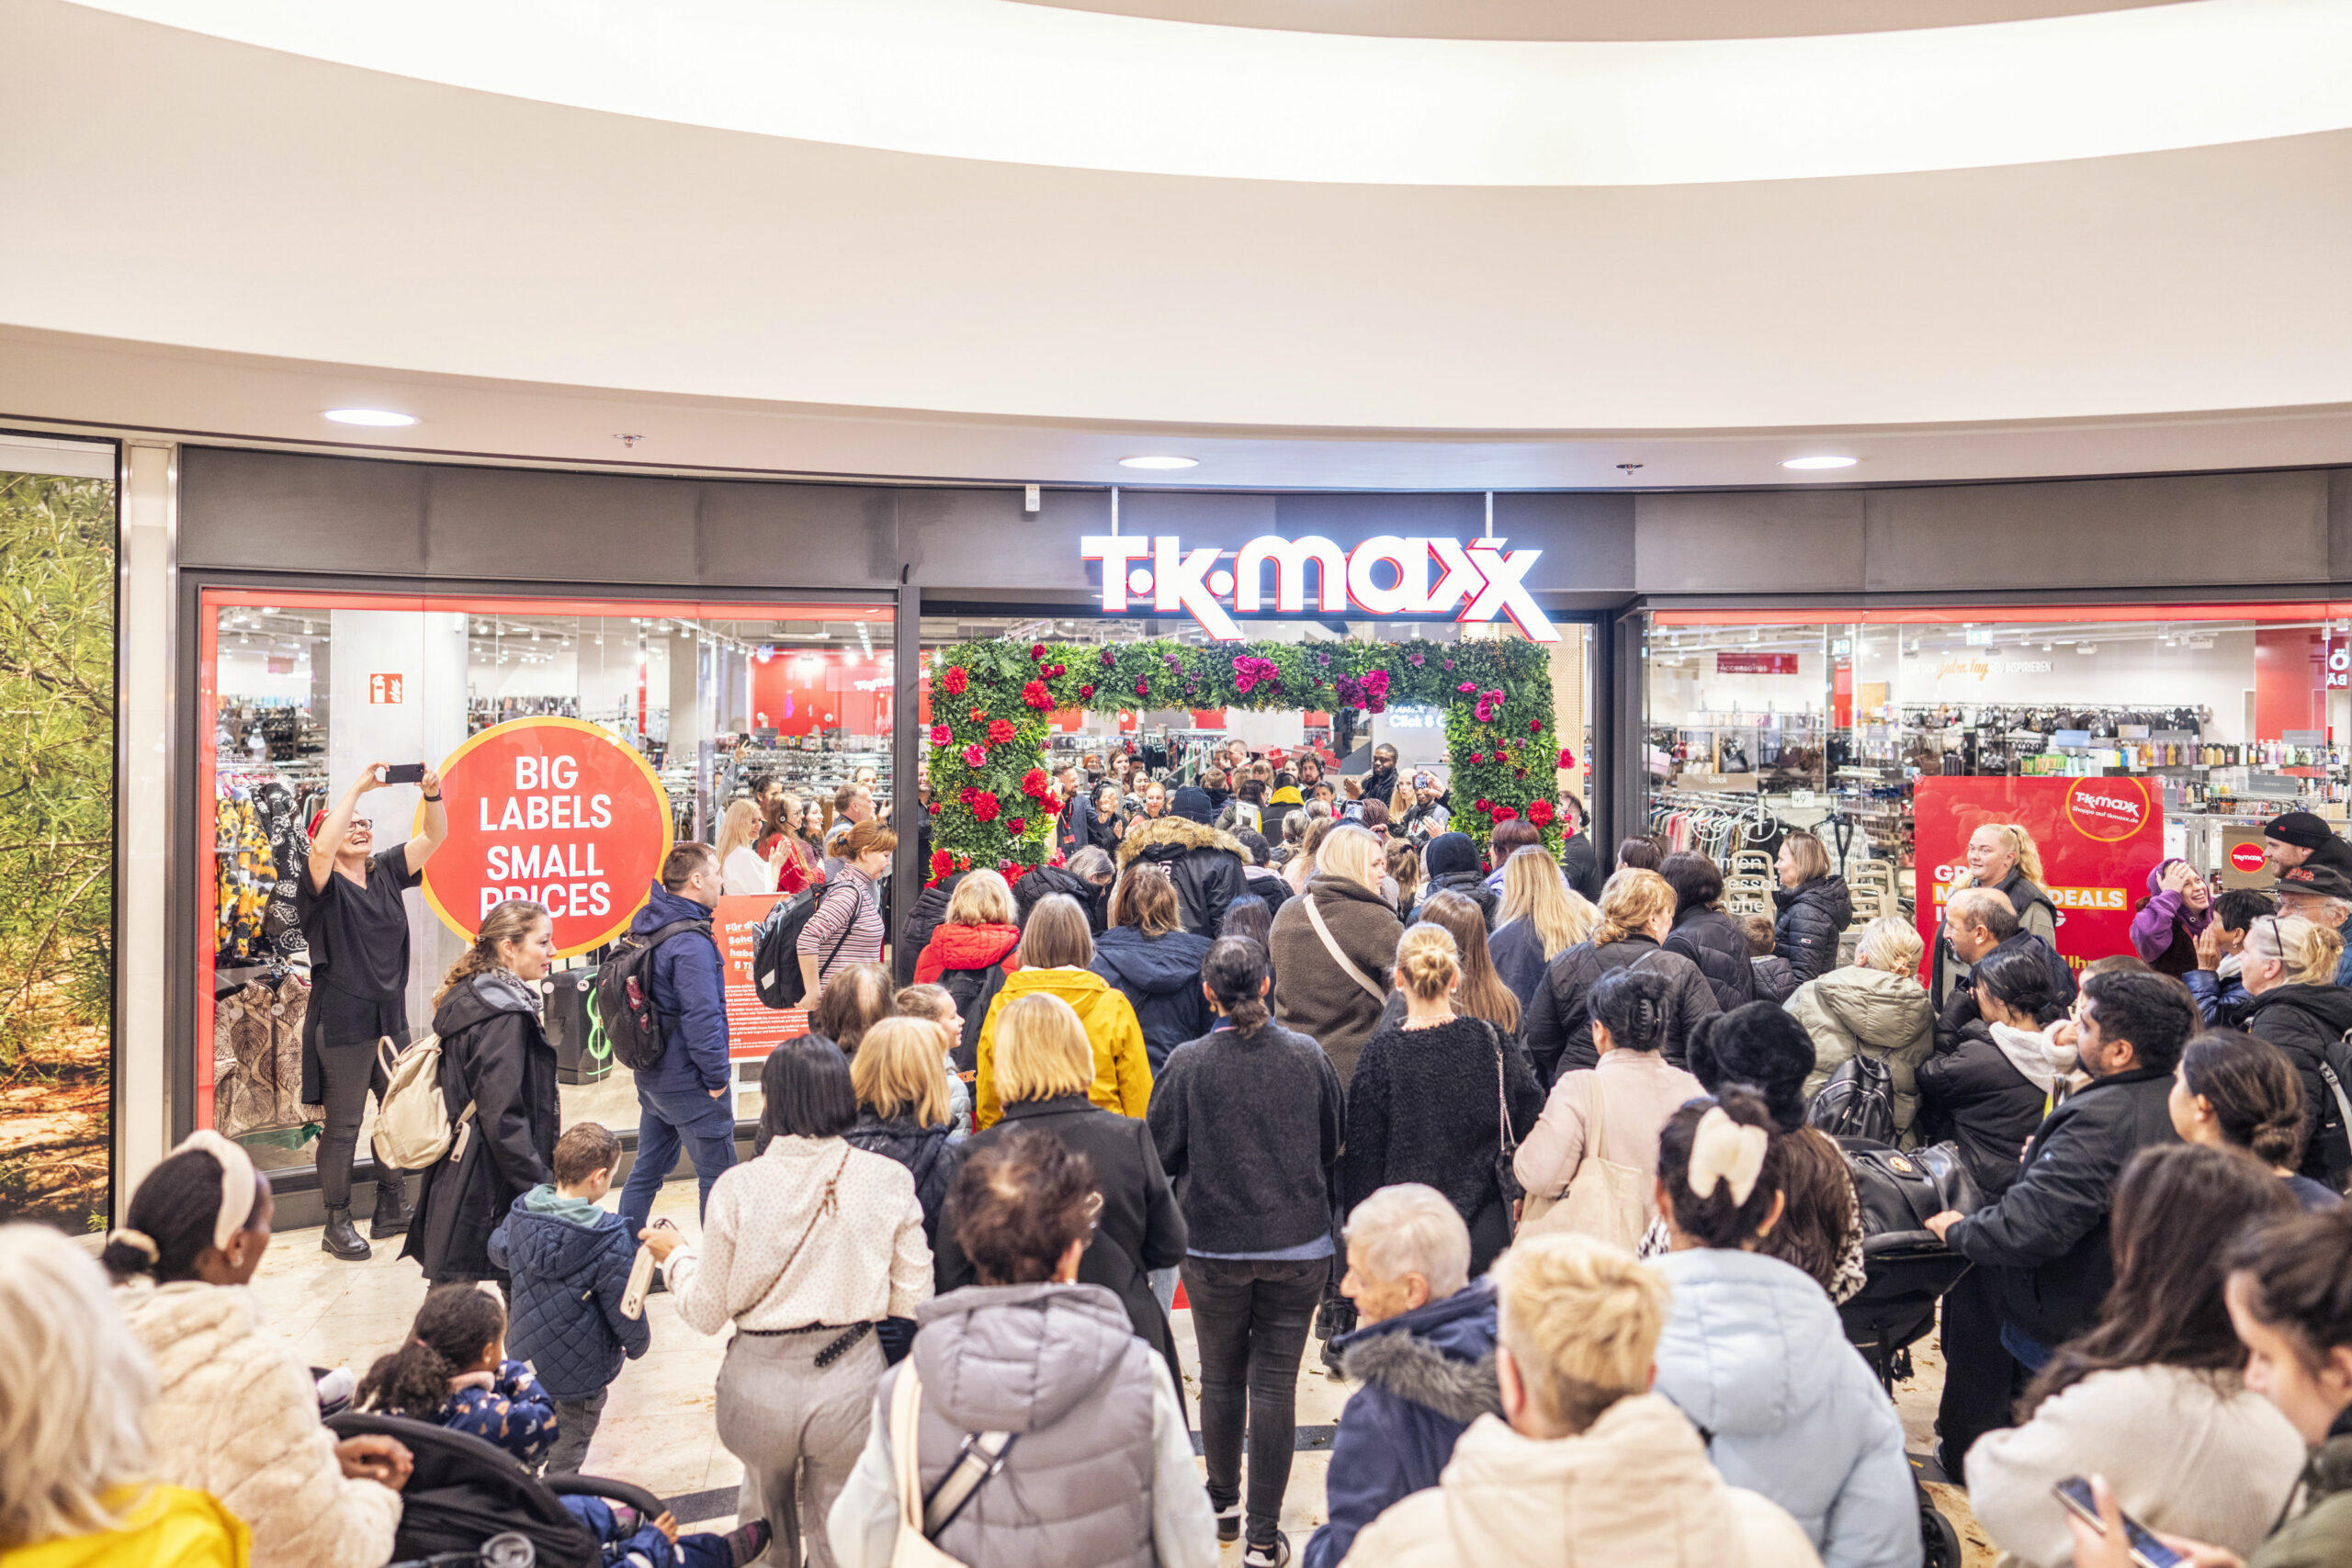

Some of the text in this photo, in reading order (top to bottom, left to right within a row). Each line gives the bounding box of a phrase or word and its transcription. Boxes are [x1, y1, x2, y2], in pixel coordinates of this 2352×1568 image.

[515, 755, 579, 790] BIG
[1708, 775, 1727, 784] Strick
[480, 794, 612, 831] LABELS
[2072, 806, 2095, 815] Shoppe
[486, 843, 605, 881] SMALL
[1711, 857, 1762, 870] men
[1719, 895, 1765, 912] uhe
[2047, 889, 2124, 908] DEALS
[725, 922, 742, 932] Für
[728, 935, 753, 944] Scha
[729, 948, 754, 957] hab
[734, 961, 741, 969] 5
